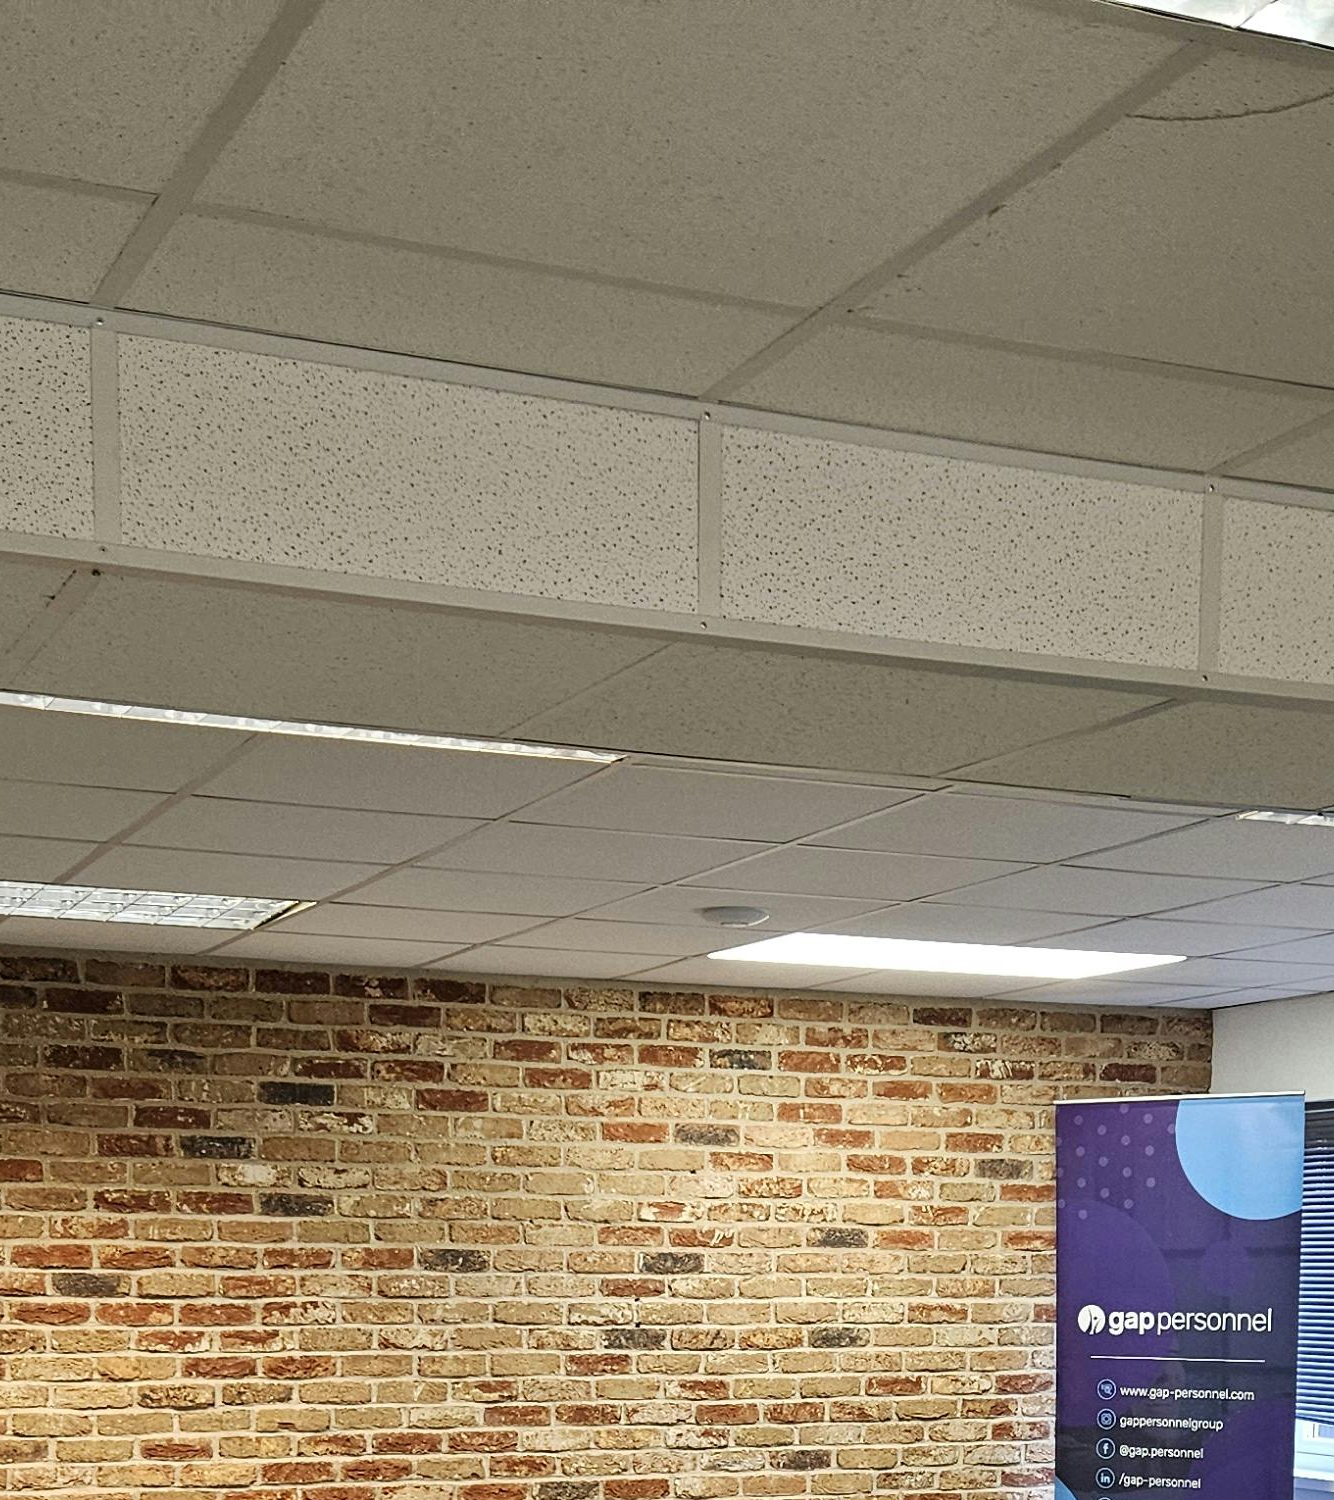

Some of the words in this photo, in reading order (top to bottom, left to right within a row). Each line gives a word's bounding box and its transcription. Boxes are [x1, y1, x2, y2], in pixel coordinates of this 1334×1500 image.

[1119, 1386, 1255, 1401] www.gap-personnel.com
[1119, 1416, 1224, 1432] gappersonnelgroup
[1119, 1444, 1204, 1459] @gap.personnel
[1118, 1472, 1201, 1489] /gap-personnel
